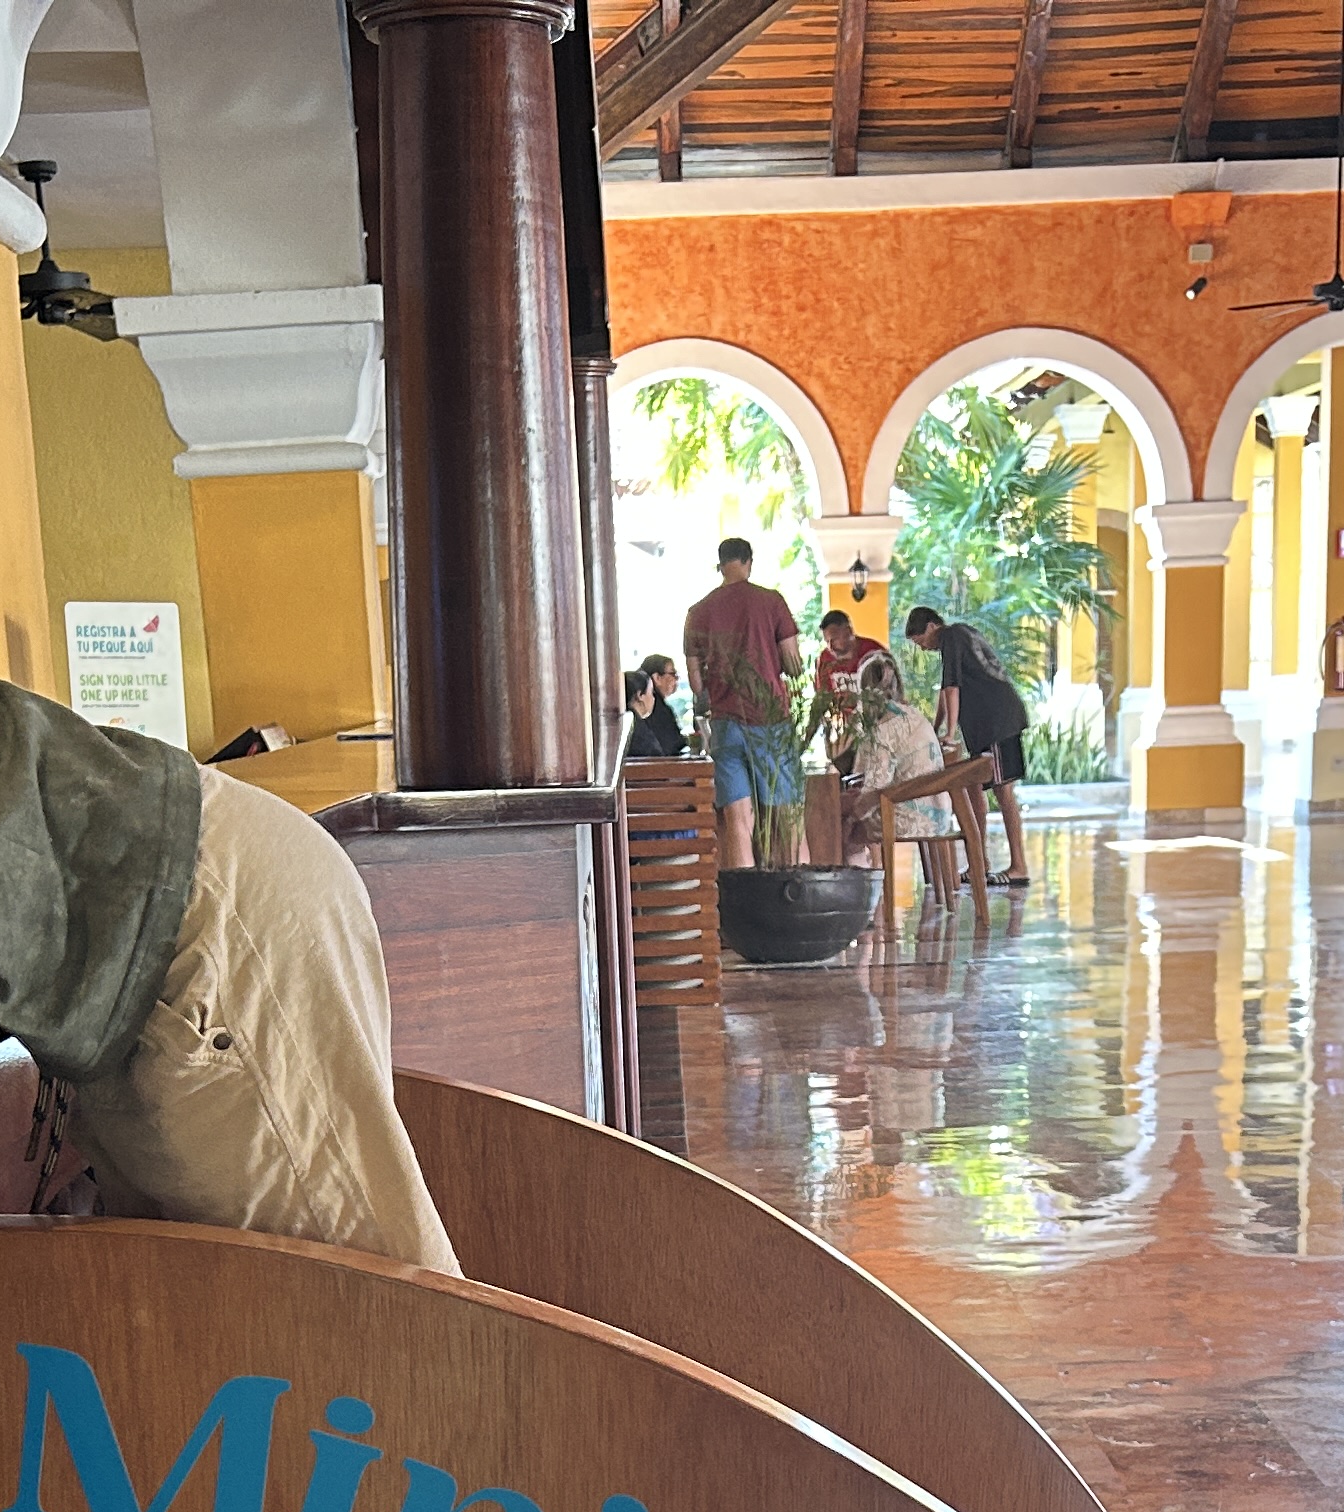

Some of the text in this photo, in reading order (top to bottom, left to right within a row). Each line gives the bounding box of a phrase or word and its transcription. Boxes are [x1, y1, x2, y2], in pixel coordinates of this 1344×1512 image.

[76, 625, 137, 638] REGISTRA A
[77, 640, 90, 653] TU
[92, 640, 127, 653] PEQUE
[79, 673, 168, 687] SIGN YOUR LITTLE
[80, 689, 149, 702] ONE UP HERE
